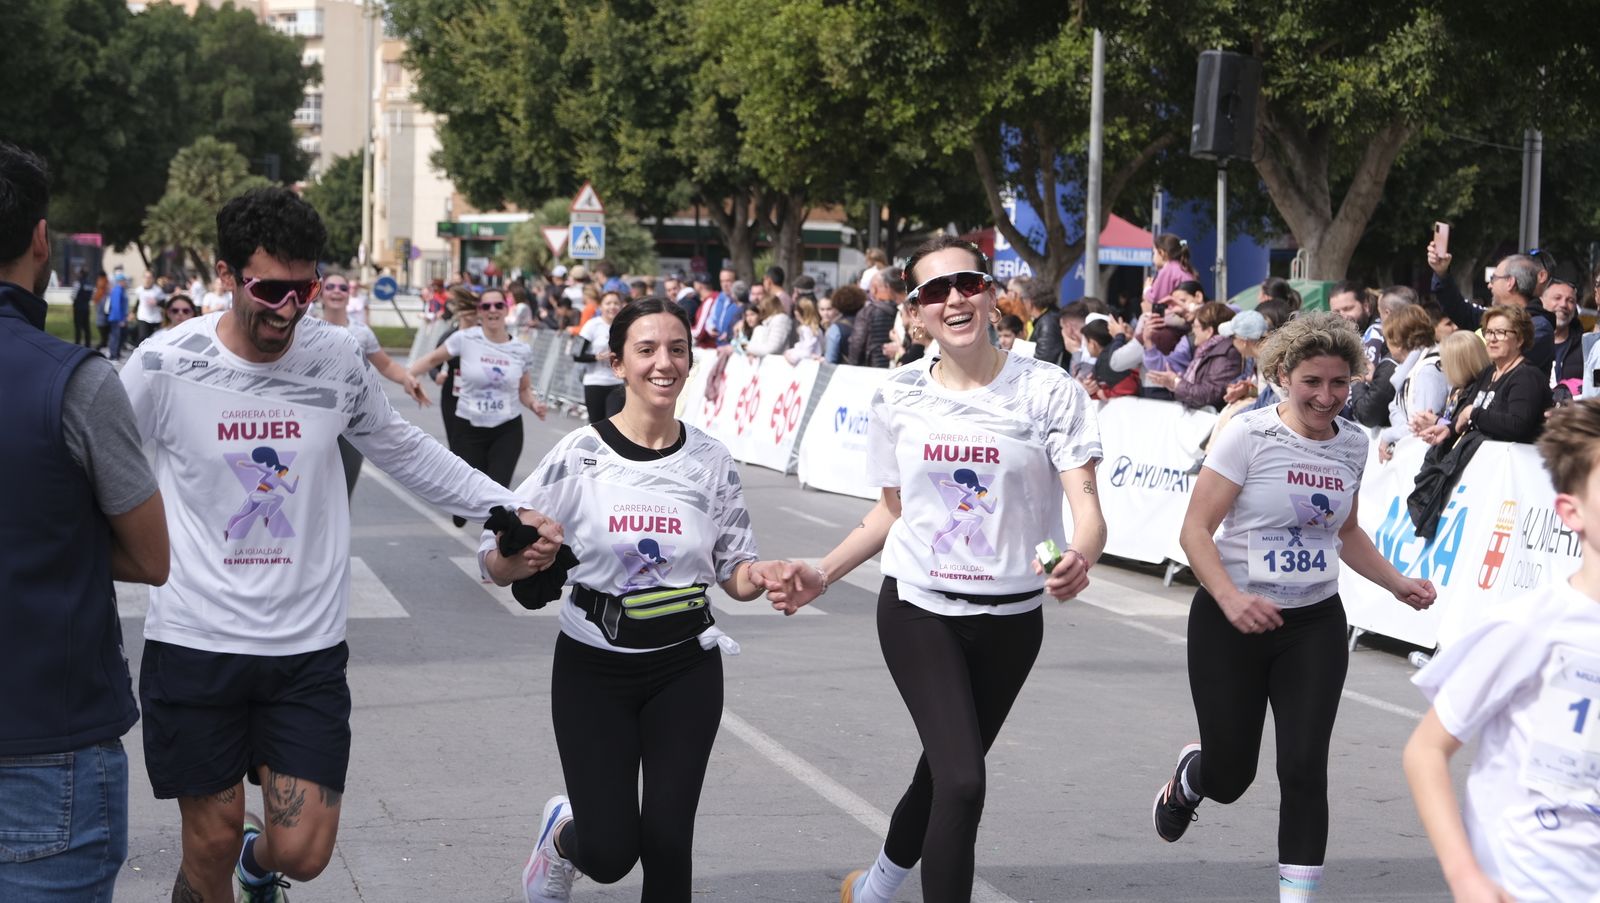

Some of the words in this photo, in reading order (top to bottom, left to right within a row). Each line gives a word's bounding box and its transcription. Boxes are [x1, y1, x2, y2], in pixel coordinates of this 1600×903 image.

[477, 400, 504, 411] 1146
[221, 409, 266, 419] CARRERA
[268, 409, 280, 418] DE
[283, 408, 295, 417] LA
[216, 421, 302, 441] MUJER
[929, 432, 969, 443] CARRERA
[971, 435, 983, 443] DE
[985, 435, 996, 444] LA
[923, 443, 1000, 464] MUJER
[1291, 463, 1322, 473] CARRERA
[1323, 467, 1332, 475] DE
[1287, 469, 1345, 492] MUJER
[613, 504, 652, 513] CARRERA
[654, 505, 666, 514] DE
[667, 506, 679, 515] LA
[608, 515, 682, 536] MUJER
[245, 547, 283, 555] IGUALDAD
[270, 557, 293, 565] META.
[1263, 549, 1327, 573] 1384
[929, 570, 939, 578] ES
[949, 564, 985, 573] IGUALDAD
[1568, 697, 1600, 735] 1
